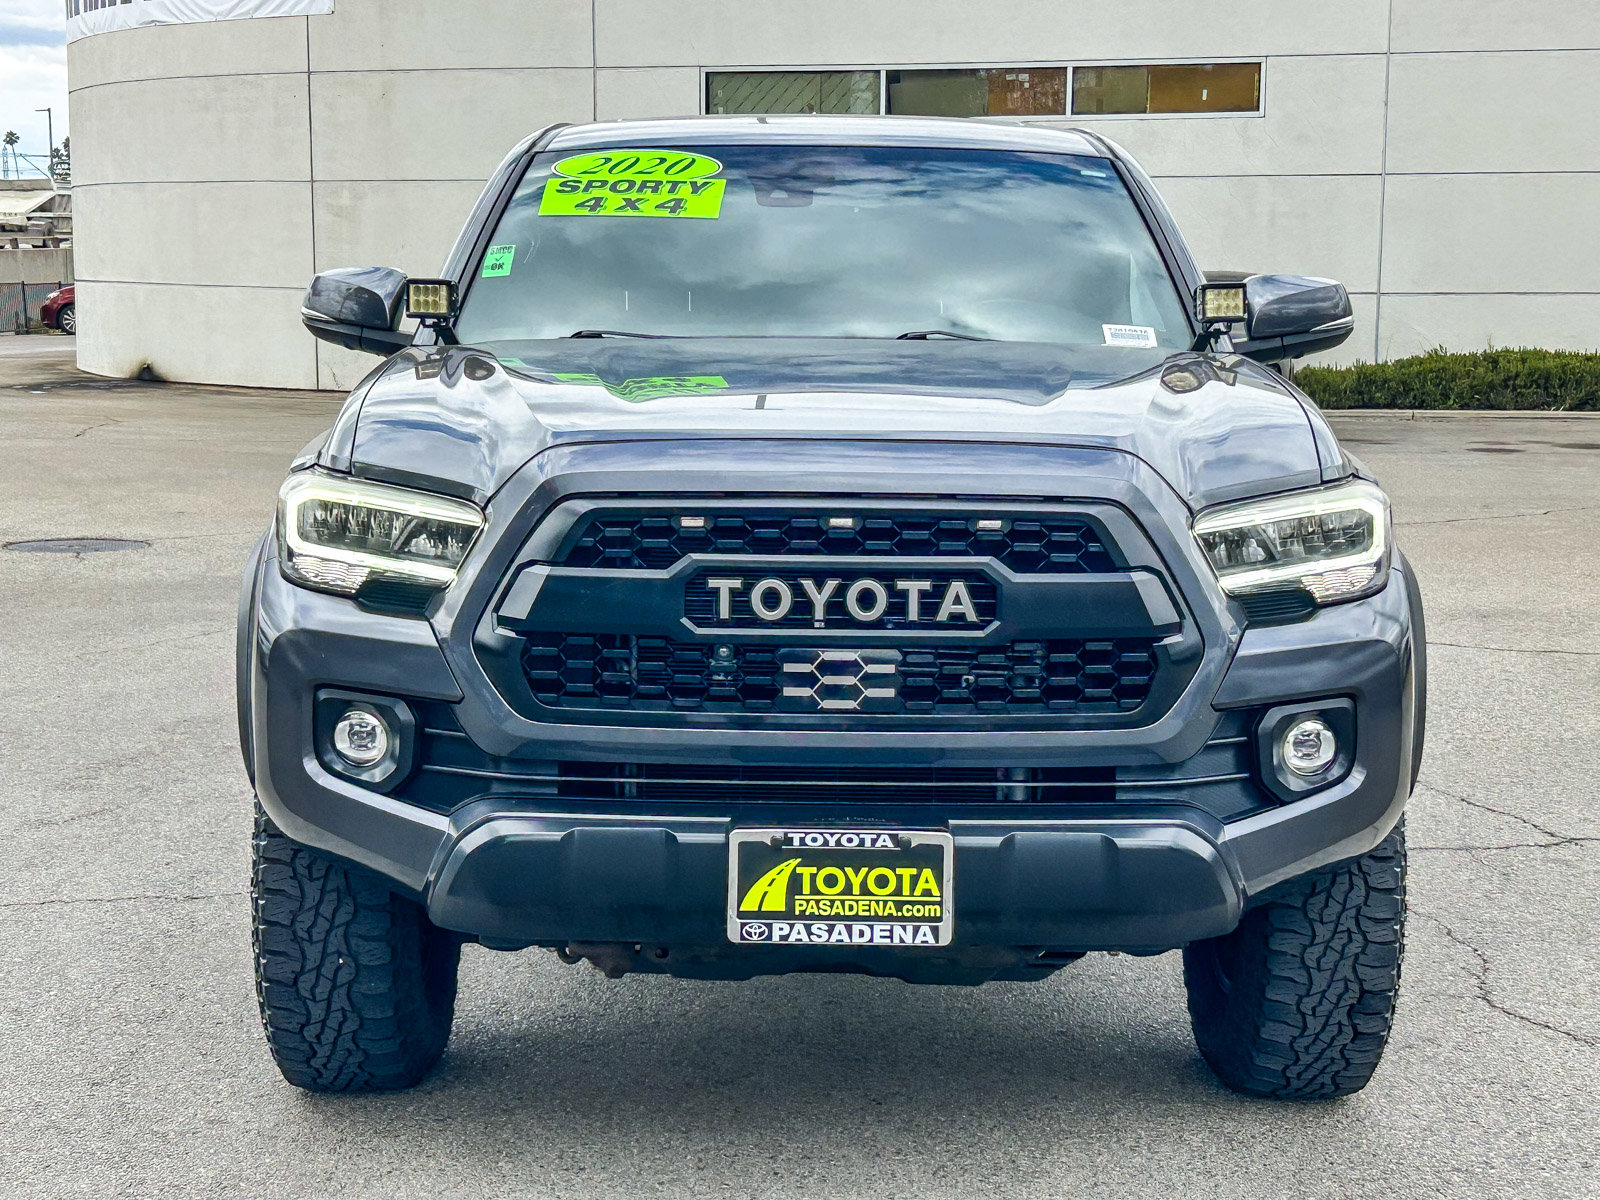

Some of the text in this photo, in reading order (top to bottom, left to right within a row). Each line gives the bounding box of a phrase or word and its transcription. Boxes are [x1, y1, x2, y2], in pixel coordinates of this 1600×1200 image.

[576, 156, 697, 176] 2020
[555, 179, 716, 197] SPORTY
[706, 577, 980, 623] TOYOTA
[787, 832, 895, 848] TOYOTA
[795, 866, 941, 897] TOYOTA
[794, 900, 941, 917] PASADENA.com
[771, 922, 936, 944] PASADENA
